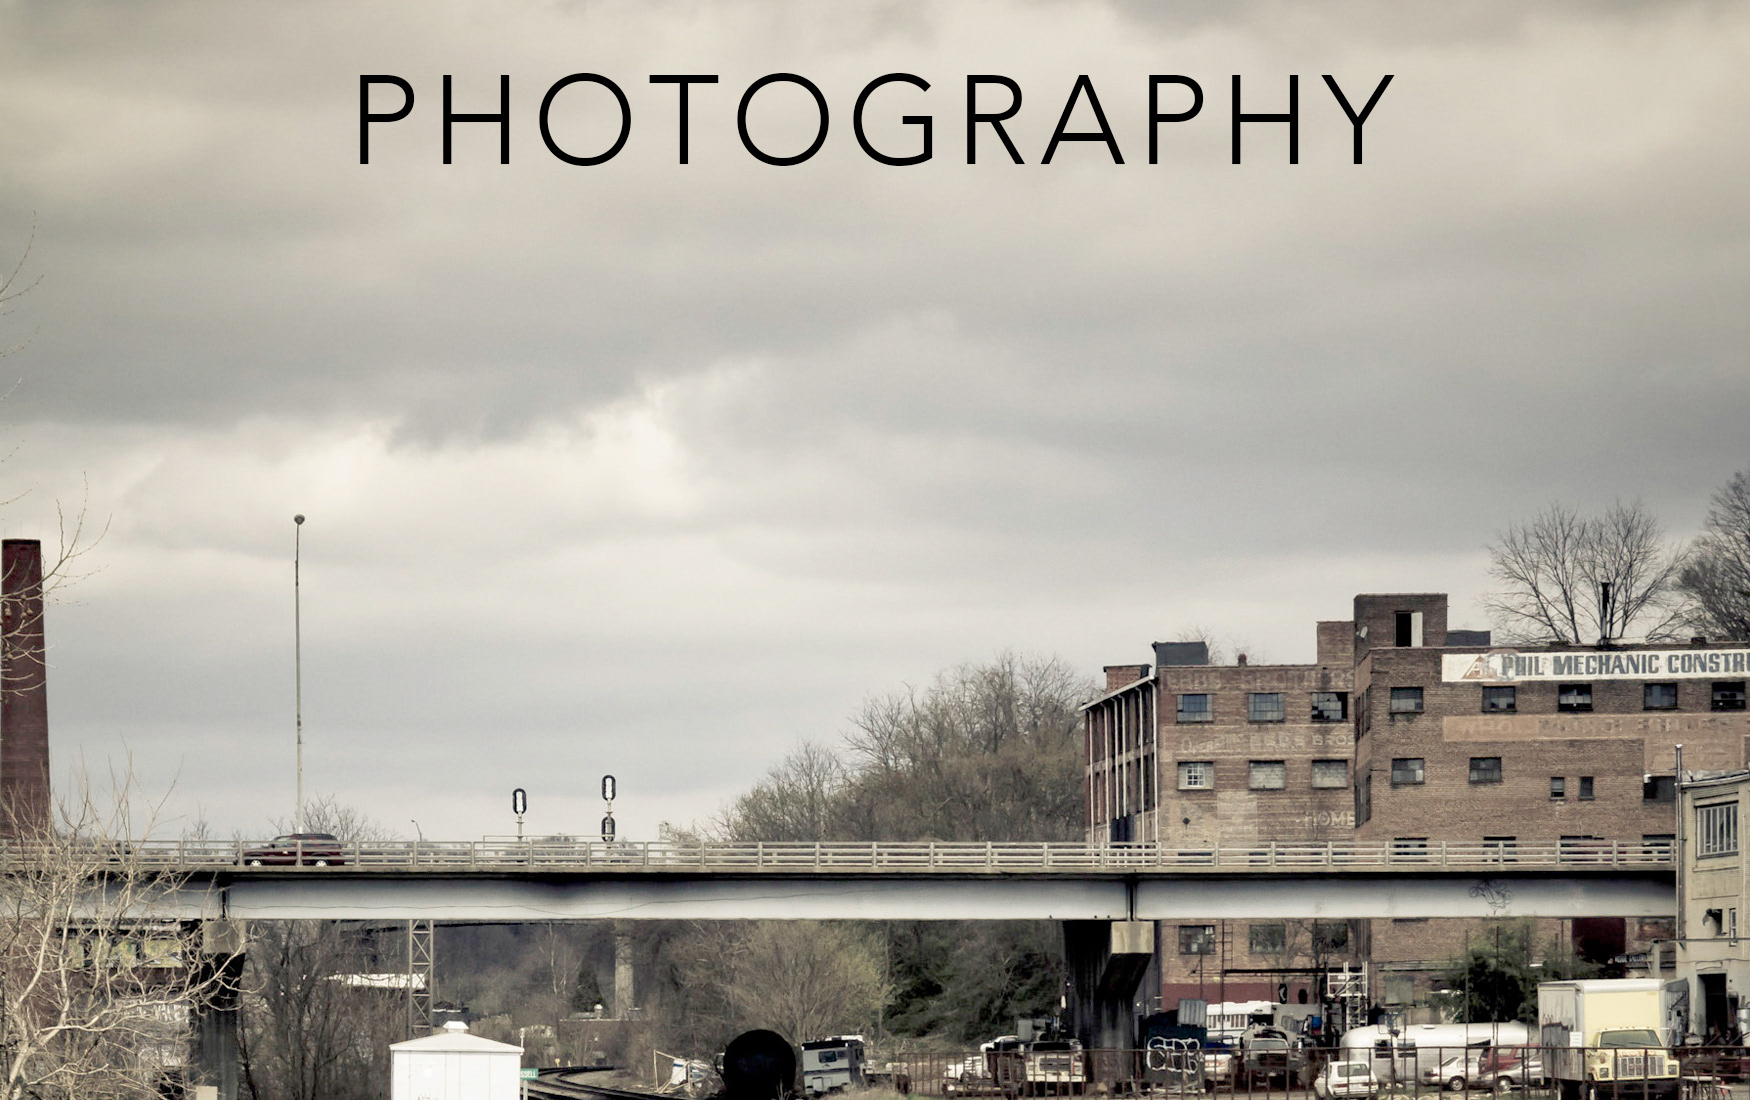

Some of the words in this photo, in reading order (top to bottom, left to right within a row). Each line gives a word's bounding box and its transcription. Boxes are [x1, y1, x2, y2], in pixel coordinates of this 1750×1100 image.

[1501, 655, 1545, 676] PHIL
[1553, 653, 1659, 676] MECHANIC
[1668, 651, 1750, 674] CONSTR
[1304, 810, 1355, 826] HOME
